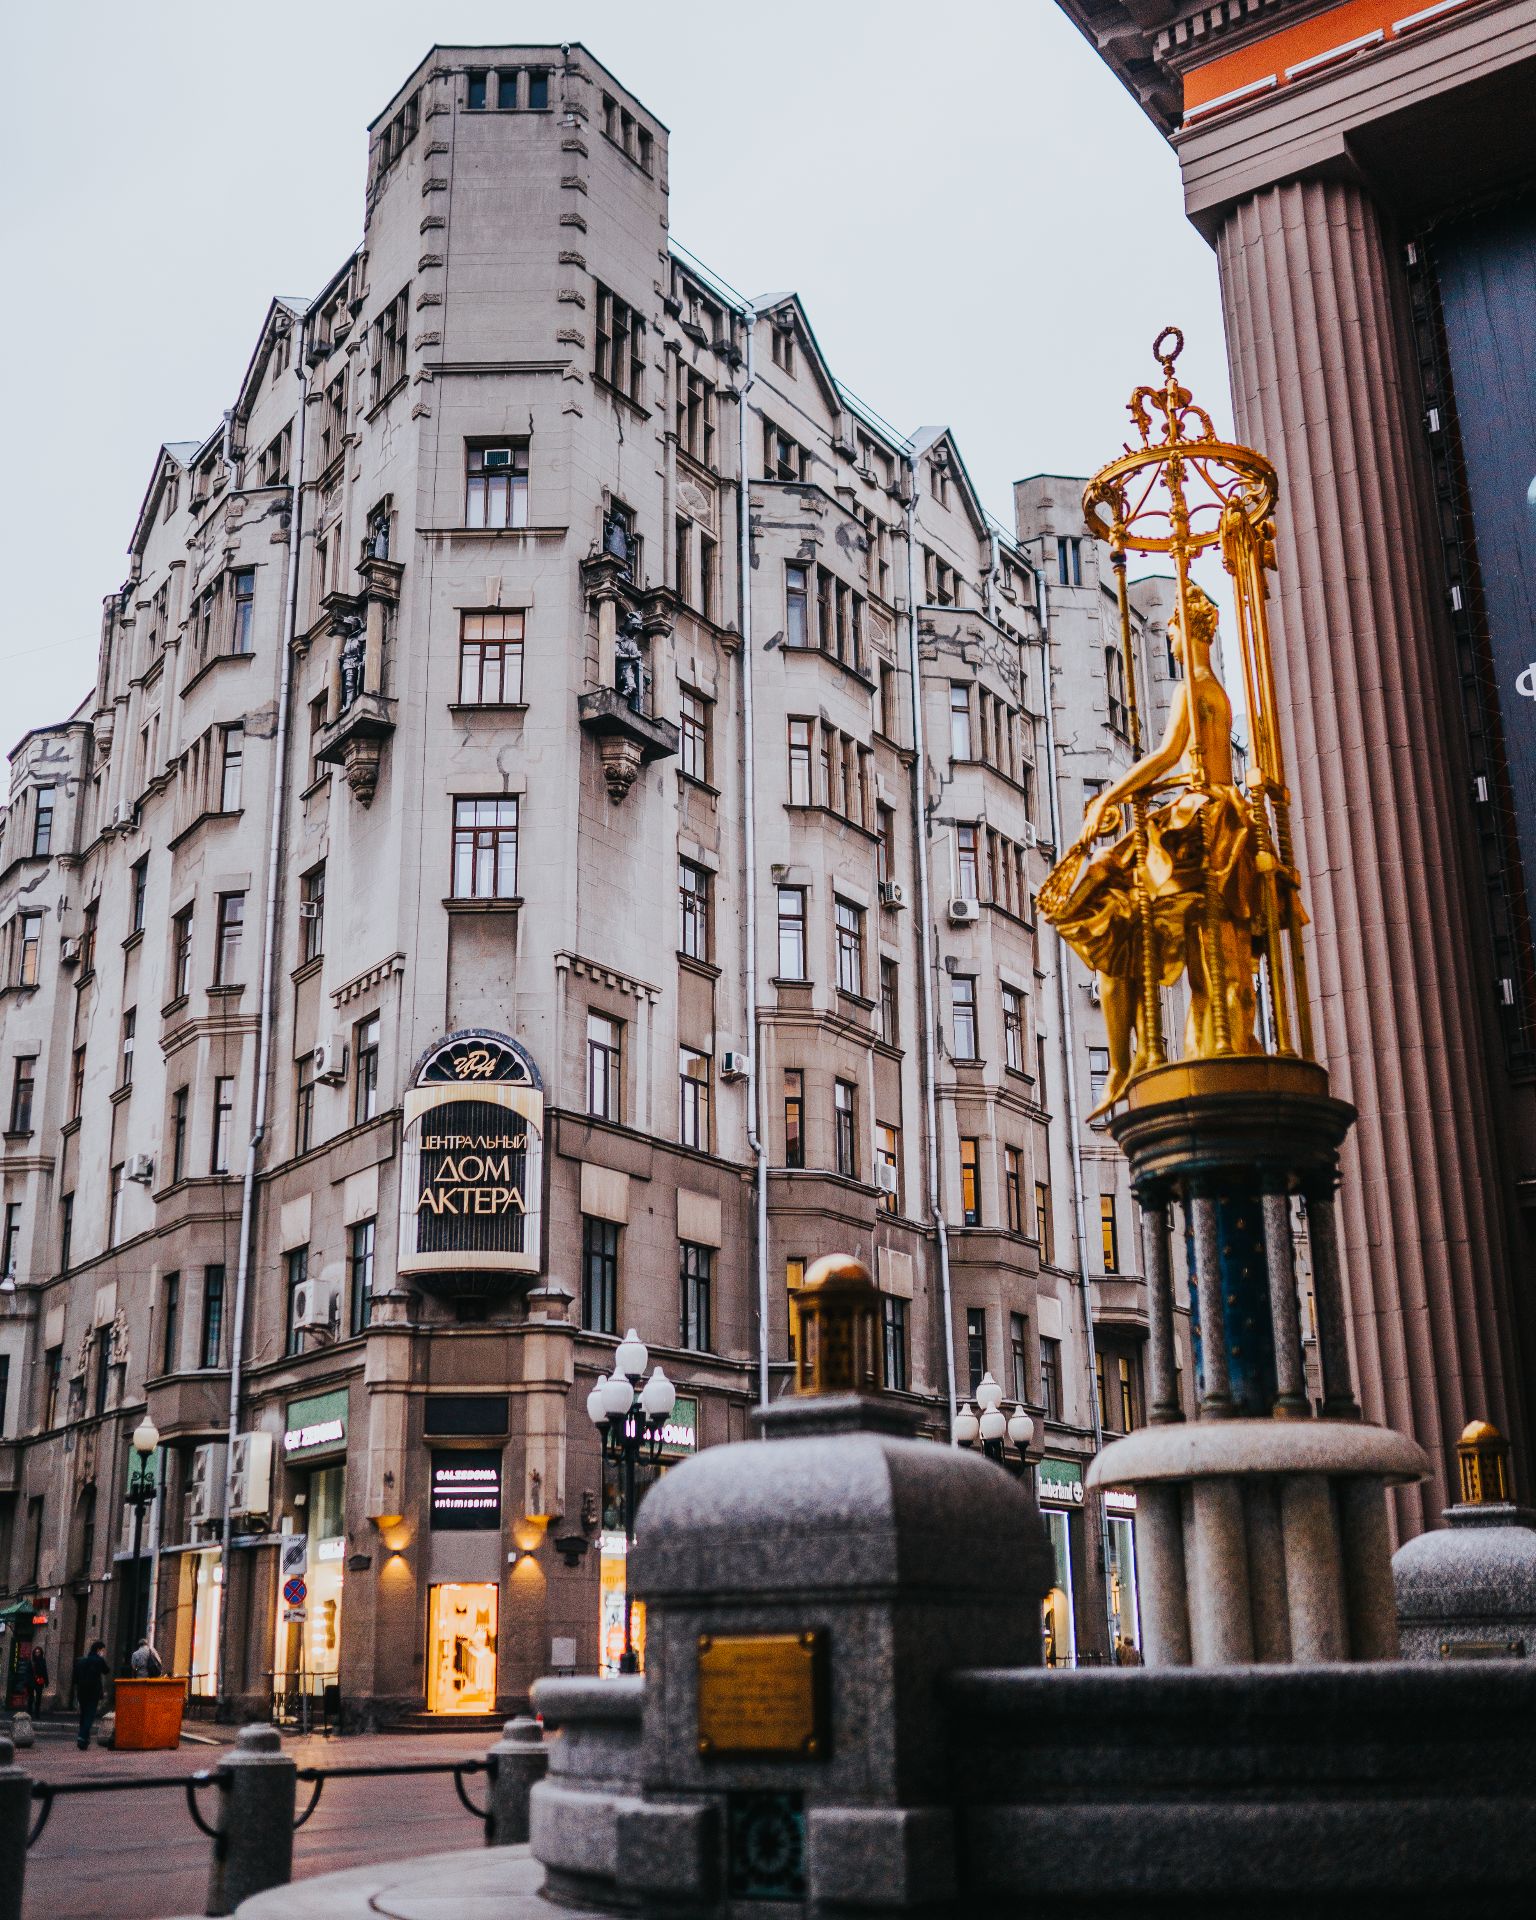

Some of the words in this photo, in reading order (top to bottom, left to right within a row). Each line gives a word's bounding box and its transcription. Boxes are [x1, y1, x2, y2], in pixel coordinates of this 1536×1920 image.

[420, 1133, 528, 1150] ЦЕНТРАЛЬНЫЙ
[434, 1155, 510, 1183] ДОМ
[416, 1187, 526, 1214] АКТЕРА
